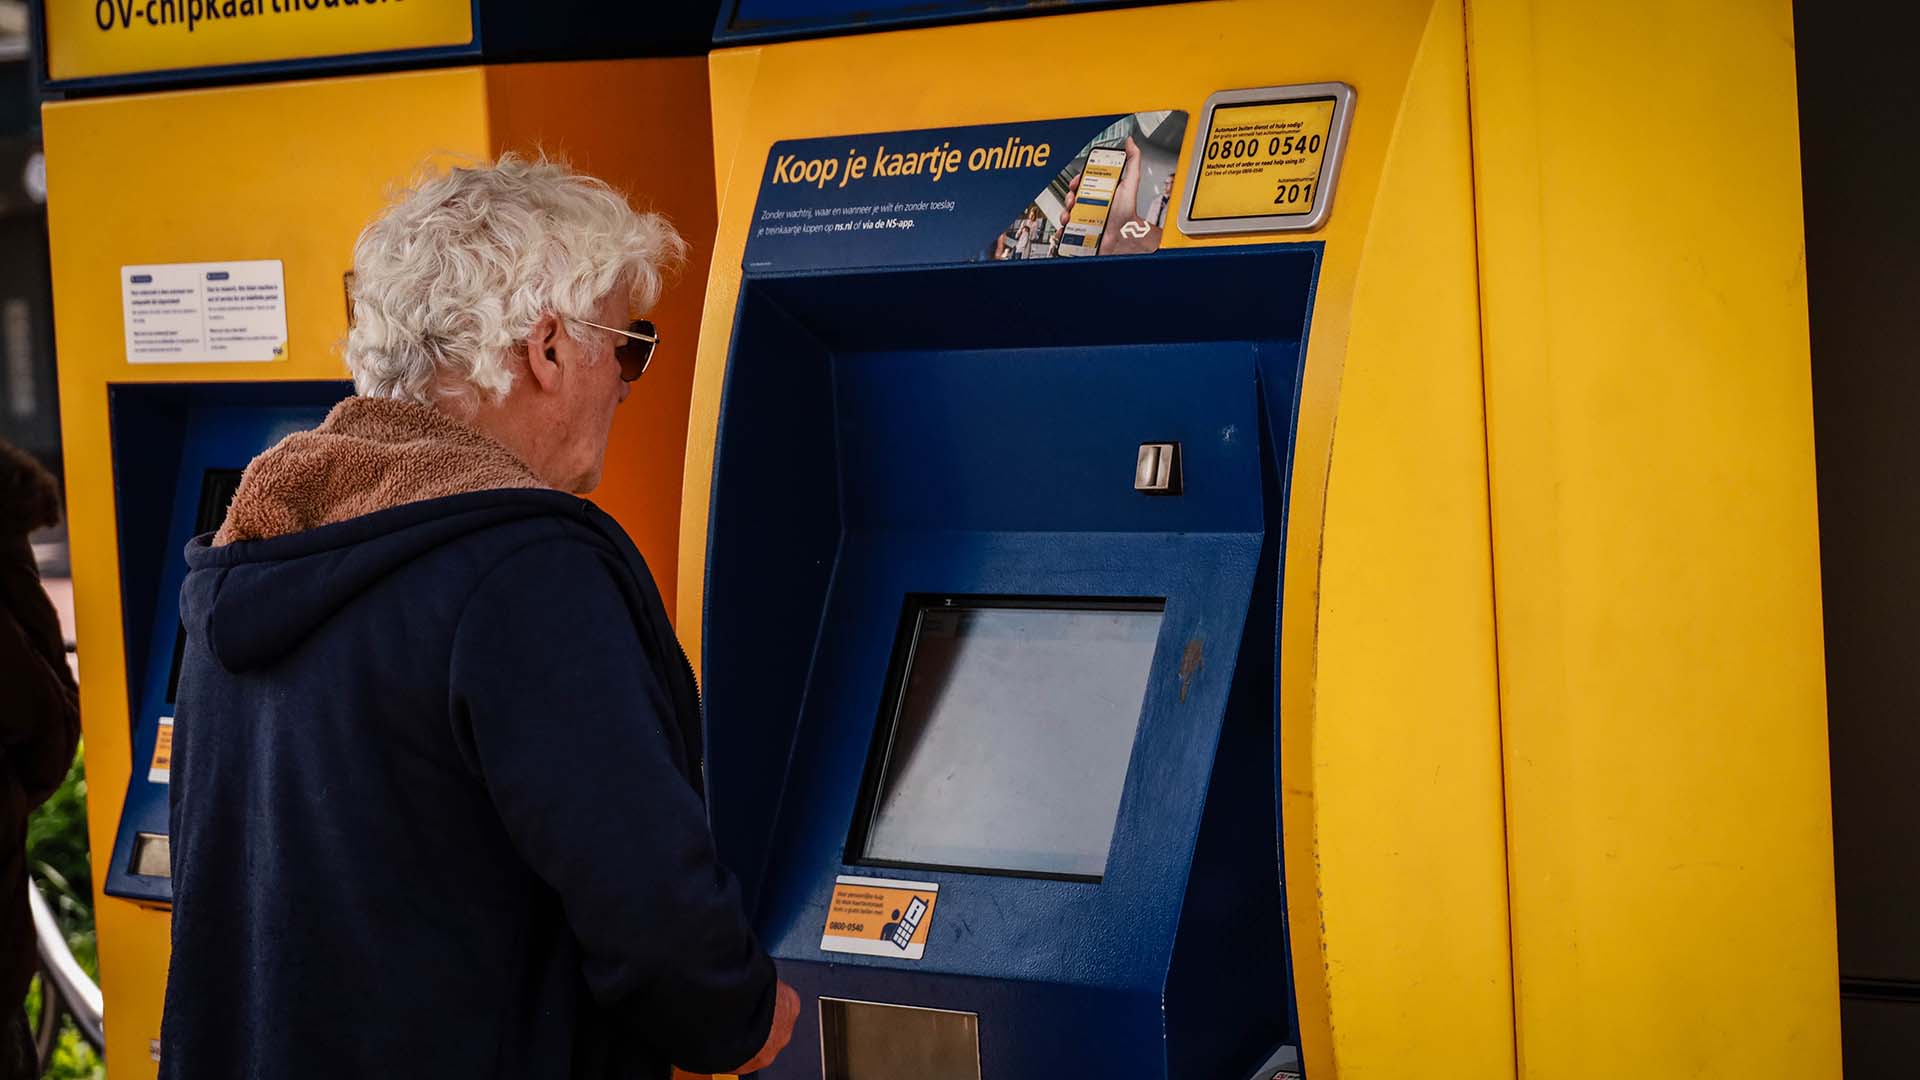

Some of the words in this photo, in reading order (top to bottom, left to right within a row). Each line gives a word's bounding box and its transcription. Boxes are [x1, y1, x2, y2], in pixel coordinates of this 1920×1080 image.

[96, 0, 404, 32] OV-chipkaar
[1287, 121, 1303, 129] nodig?
[1208, 139, 1259, 160] 0800
[1268, 134, 1320, 156] 0540
[772, 155, 839, 189] Koop
[839, 149, 867, 188] je
[872, 142, 962, 182] kaartje
[968, 137, 1051, 172] online
[1274, 184, 1312, 204] 201
[761, 209, 785, 220] Zonder
[786, 207, 813, 220] wachtrij,
[815, 208, 832, 217] waar
[832, 207, 841, 216] en
[842, 205, 872, 216] wanneer
[872, 203, 880, 216] je
[880, 202, 893, 212] wilt
[894, 201, 904, 212] én
[904, 200, 929, 212] zonder
[930, 199, 955, 212] toeslag
[756, 225, 764, 239] je
[765, 224, 801, 237] treinkaartje
[802, 223, 823, 236] kopen
[824, 224, 834, 235] op
[834, 220, 853, 231] ns.nl
[853, 219, 862, 230] of
[862, 219, 874, 230] via
[874, 218, 885, 229] de
[885, 218, 915, 230] NS-app.
[829, 920, 864, 932] 0800-0540
